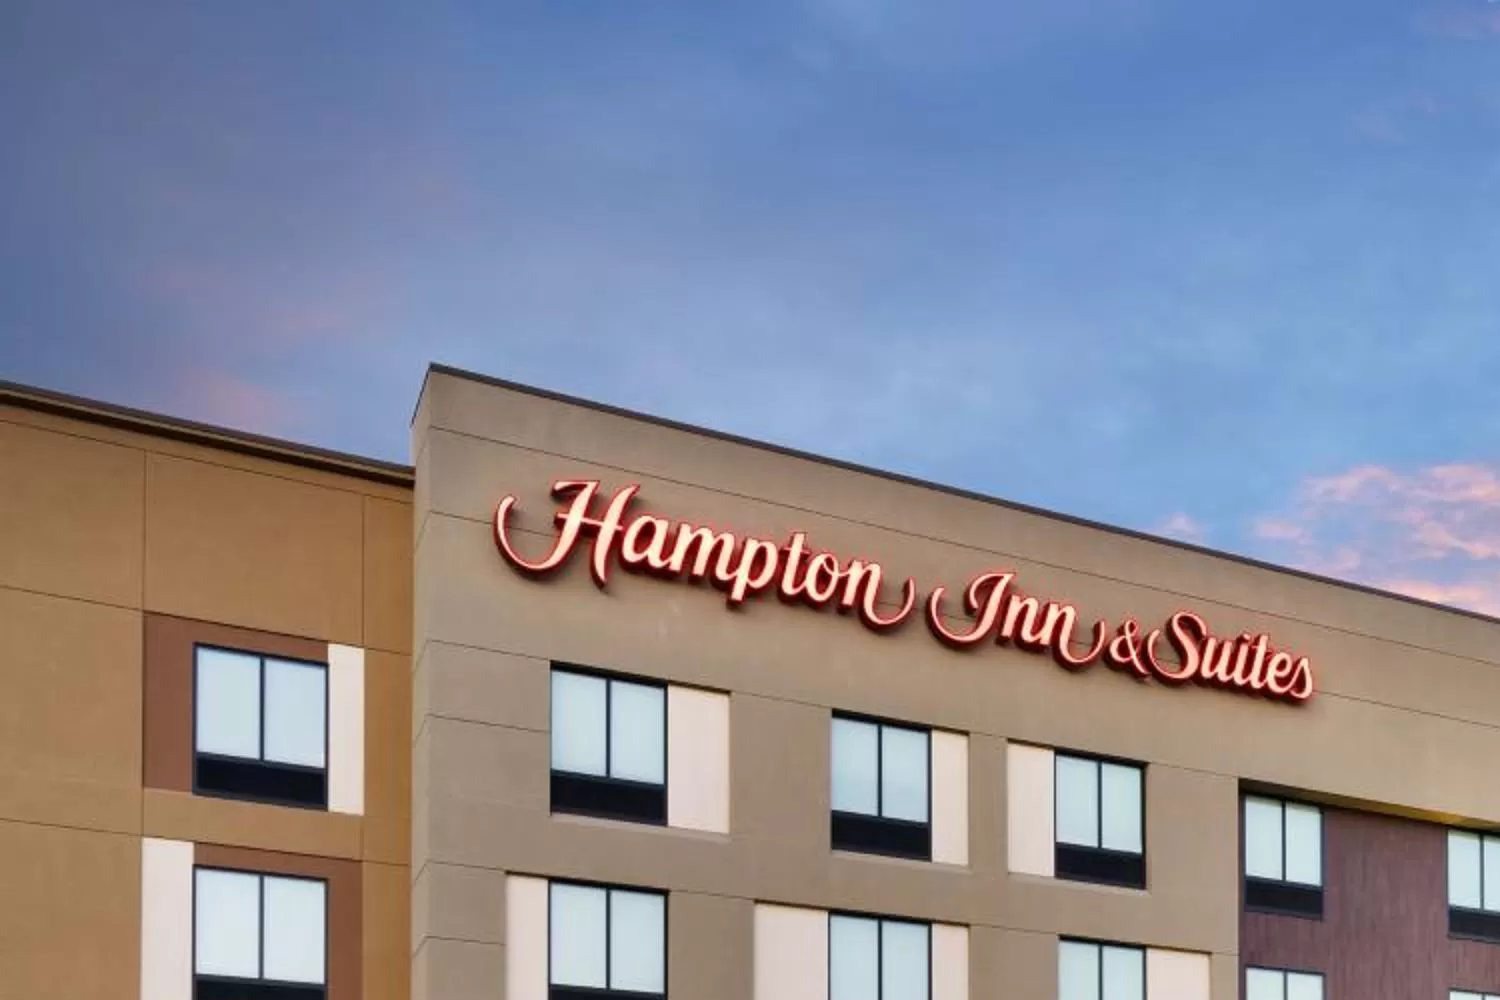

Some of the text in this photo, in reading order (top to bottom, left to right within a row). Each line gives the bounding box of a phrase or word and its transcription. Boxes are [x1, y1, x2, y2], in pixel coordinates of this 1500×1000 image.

[493, 479, 916, 633] Hampton
[926, 572, 1106, 671] Inn
[1146, 610, 1314, 703] Suites
